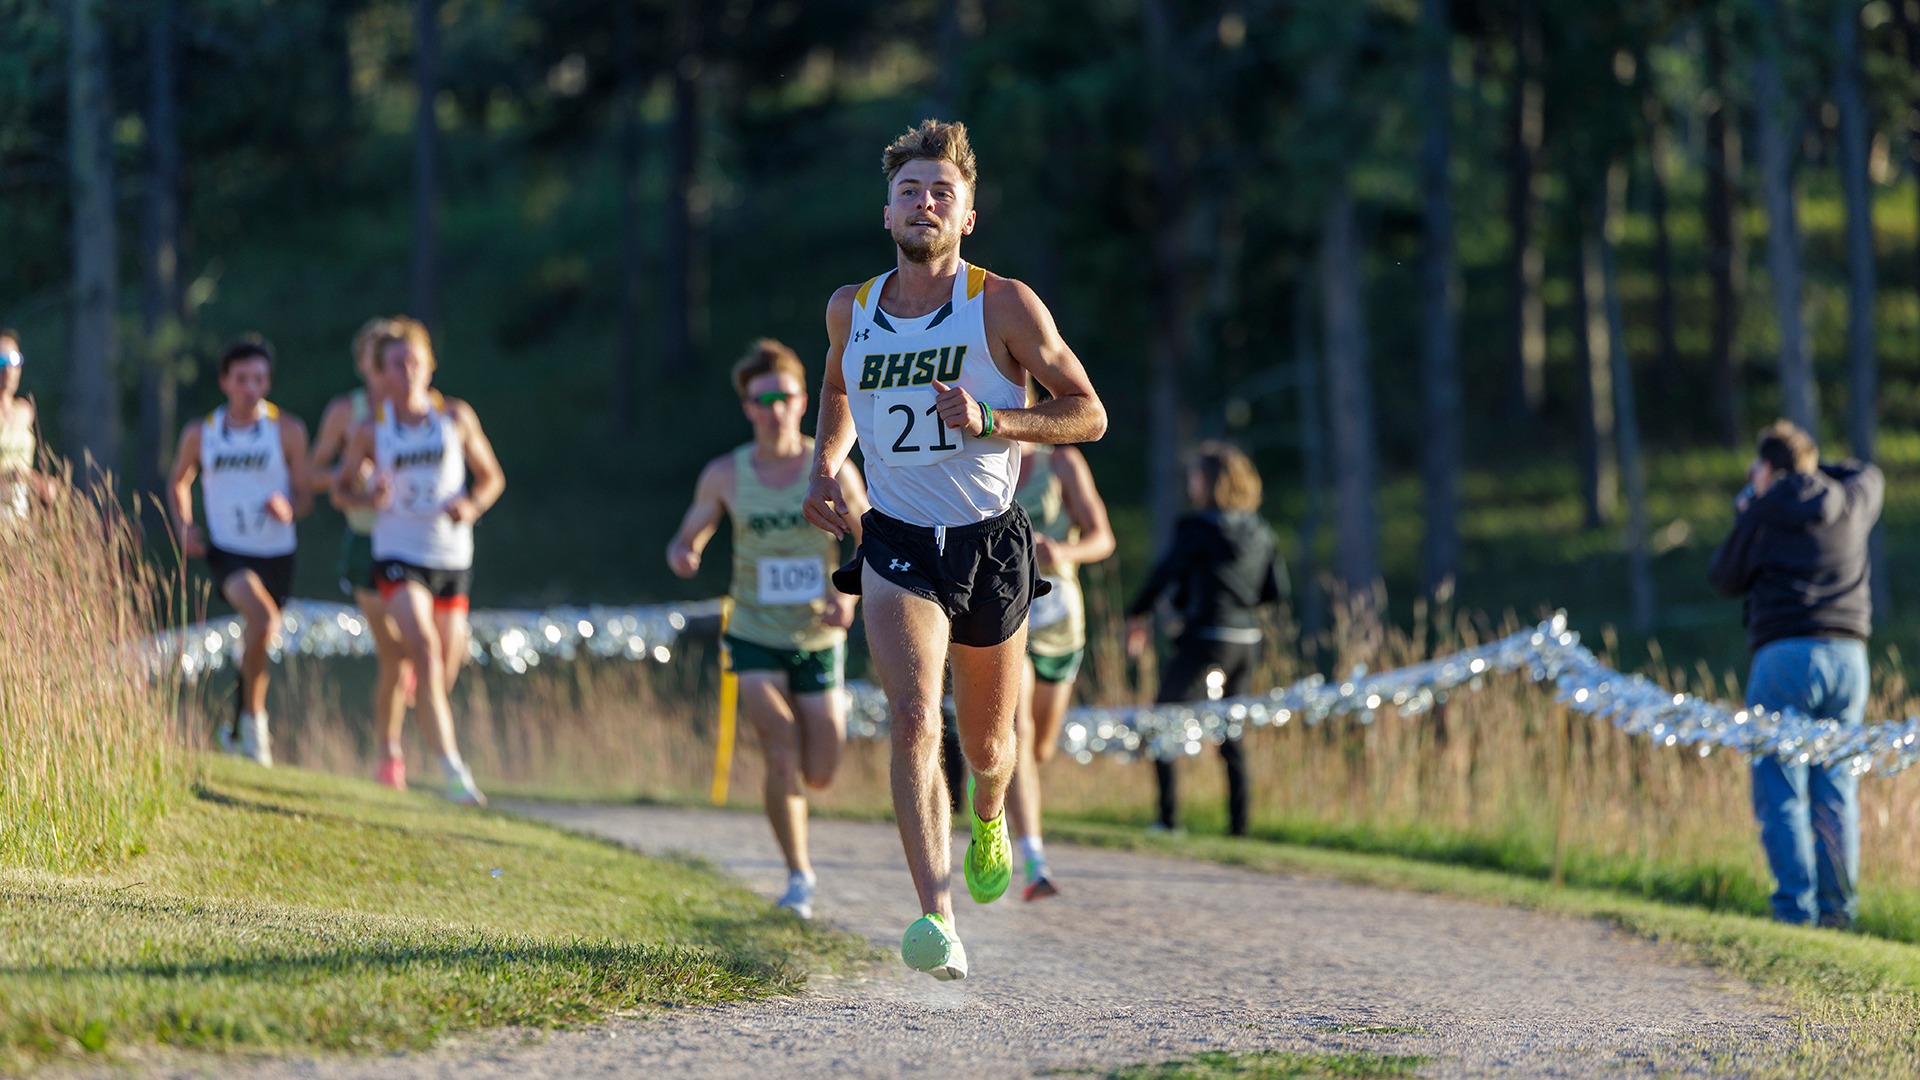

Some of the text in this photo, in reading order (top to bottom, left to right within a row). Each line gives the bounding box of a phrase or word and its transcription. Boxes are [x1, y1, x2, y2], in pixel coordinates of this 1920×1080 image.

[858, 345, 968, 391] BHSU
[888, 404, 957, 453] 21
[767, 563, 820, 592] 109
